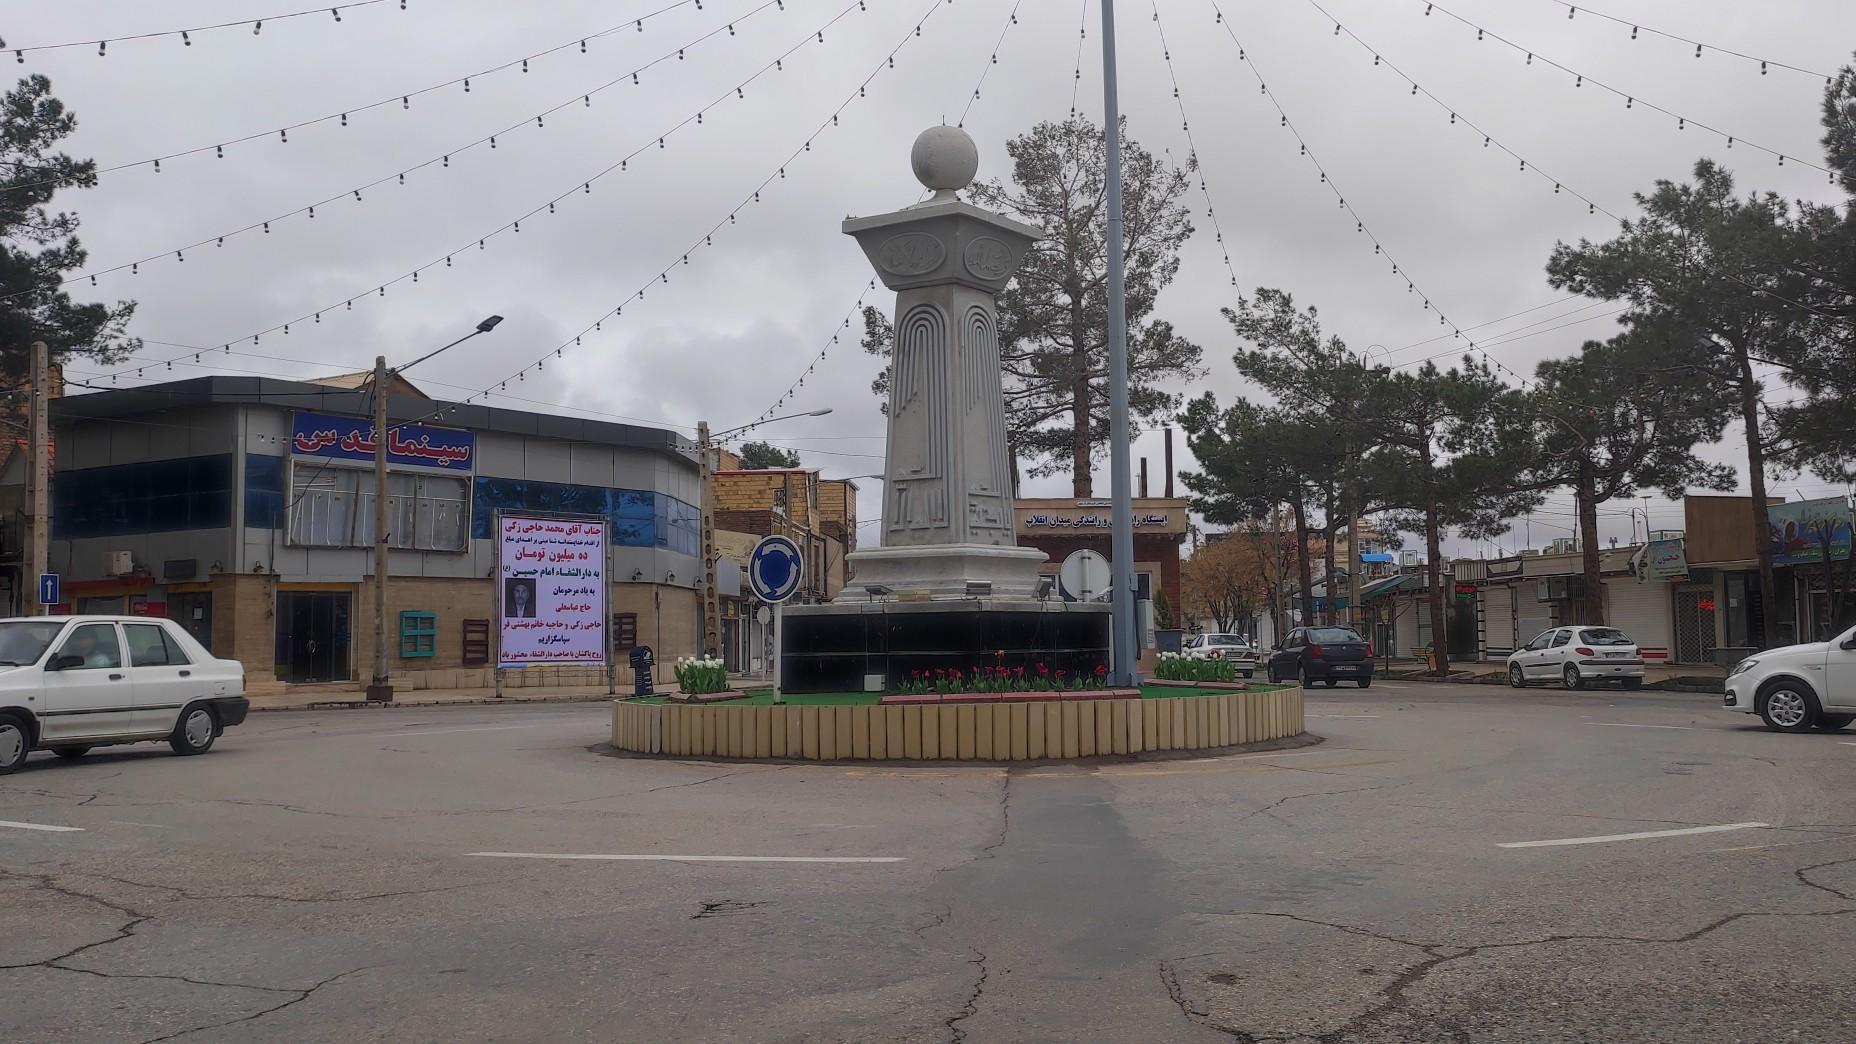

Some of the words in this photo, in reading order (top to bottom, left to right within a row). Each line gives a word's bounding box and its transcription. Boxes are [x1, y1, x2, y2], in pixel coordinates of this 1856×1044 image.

[388, 428, 469, 465] سینما
[1025, 515, 1047, 528] انقلاب
[1050, 515, 1071, 528] میدان
[1073, 515, 1101, 528] رانندگی
[1102, 519, 1108, 528] و
[1142, 514, 1168, 528] ایستگاه
[505, 522, 521, 533] زکی
[522, 522, 543, 534] حاجی
[566, 525, 582, 536] آقای
[584, 526, 600, 536] جناب
[515, 547, 545, 561] تومان
[549, 549, 574, 562] میلیون
[579, 551, 588, 560] ده
[513, 568, 538, 577] حسین
[540, 567, 554, 578] امام
[594, 571, 600, 580] به
[553, 586, 579, 596] مرحومان
[580, 587, 589, 595] یاد
[590, 588, 595, 597] به
[556, 603, 578, 613] عباسعلی
[580, 604, 591, 612] حاج
[531, 620, 544, 629] خانم
[546, 621, 563, 630] حاجیه
[571, 620, 583, 630] زکی
[585, 621, 601, 630] حاجی
[538, 635, 570, 645] سپاسگزاریم
